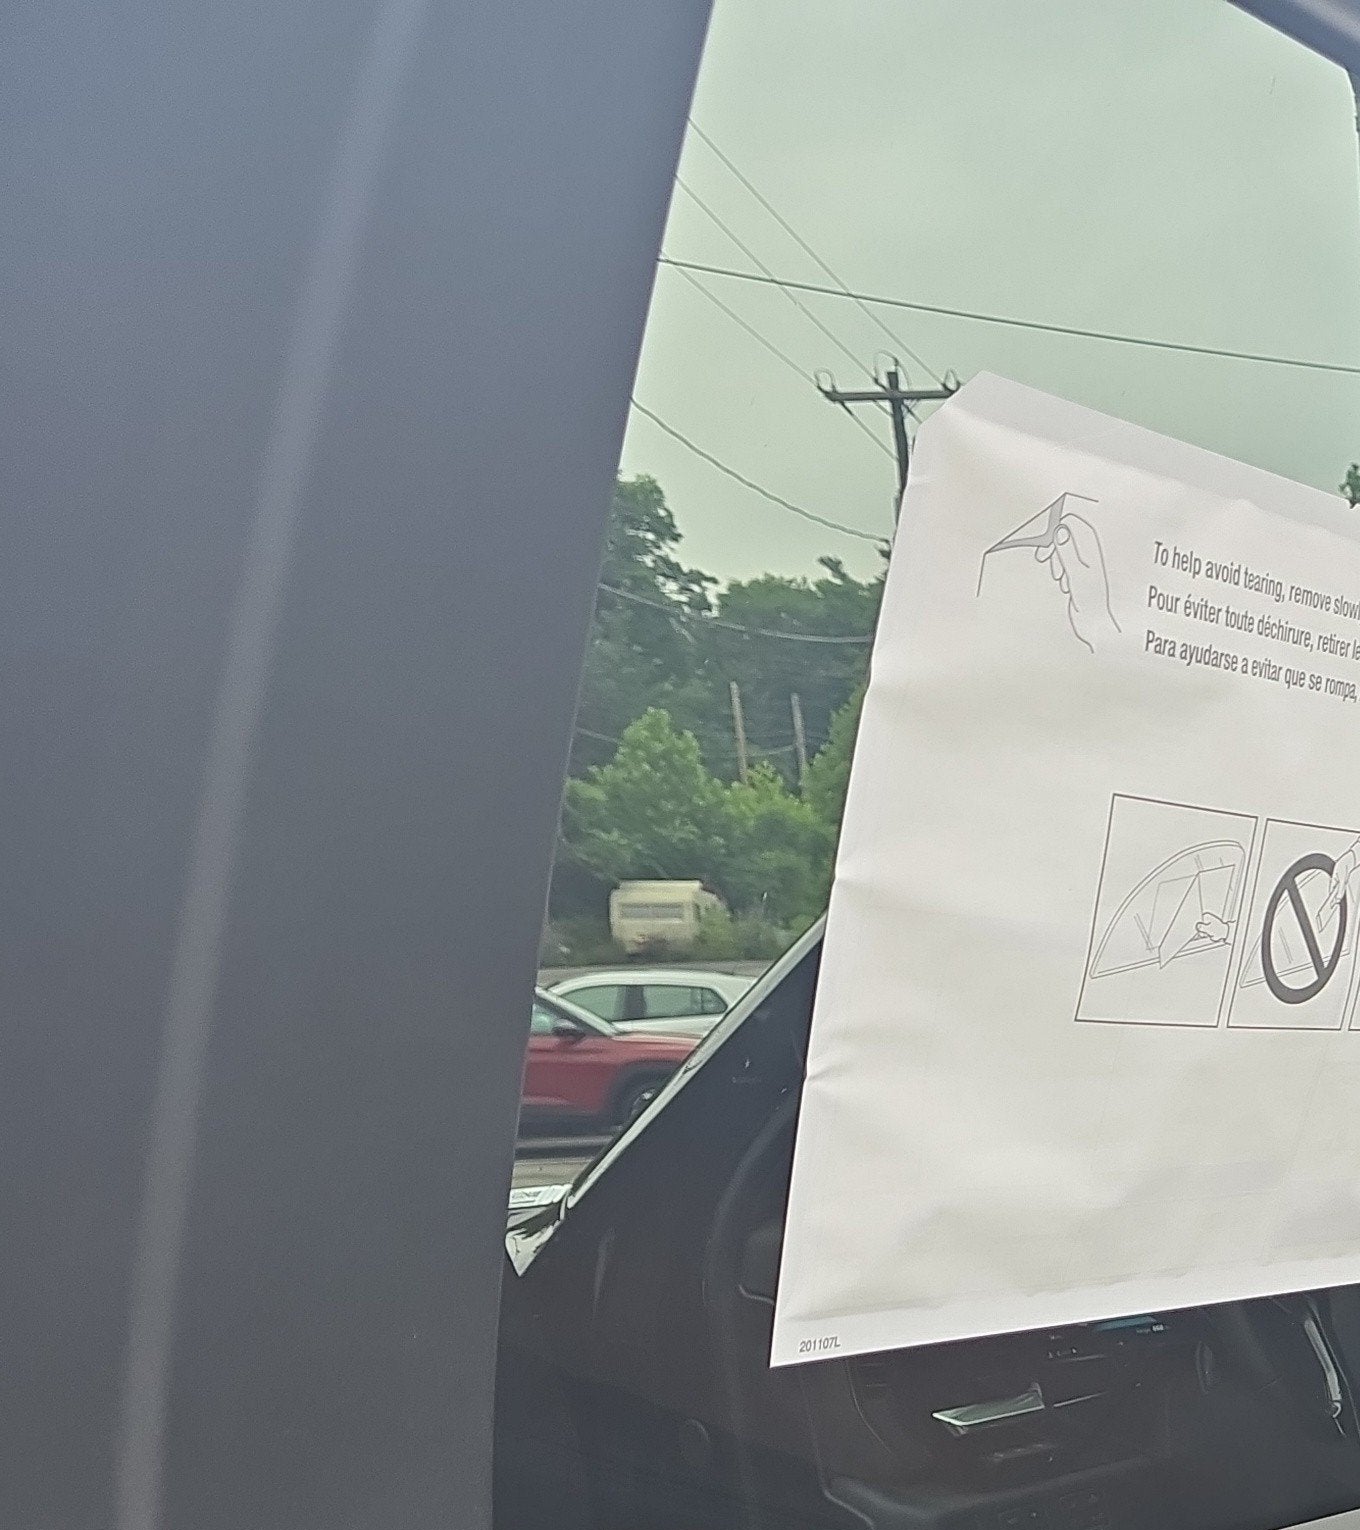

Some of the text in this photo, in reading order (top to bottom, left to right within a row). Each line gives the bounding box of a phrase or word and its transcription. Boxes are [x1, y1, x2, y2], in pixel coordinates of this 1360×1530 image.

[1154, 541, 1168, 566] To
[1172, 546, 1202, 579] help
[1205, 561, 1241, 586] avoid
[1244, 567, 1285, 603] tearing,
[1288, 585, 1332, 611] remove
[1148, 585, 1180, 614] Pour
[1184, 594, 1222, 624] éviter
[1225, 606, 1254, 633] toute
[1257, 614, 1313, 652] déchirure,
[1316, 633, 1351, 657] retirer
[1145, 630, 1176, 657] Para
[1180, 642, 1238, 671] ayudarse
[1241, 657, 1249, 674] a
[1251, 658, 1282, 681] evitar
[1284, 667, 1306, 689] que
[1308, 673, 1323, 691] se
[1324, 677, 1357, 703] rompa,
[799, 1336, 841, 1353] 201107L
